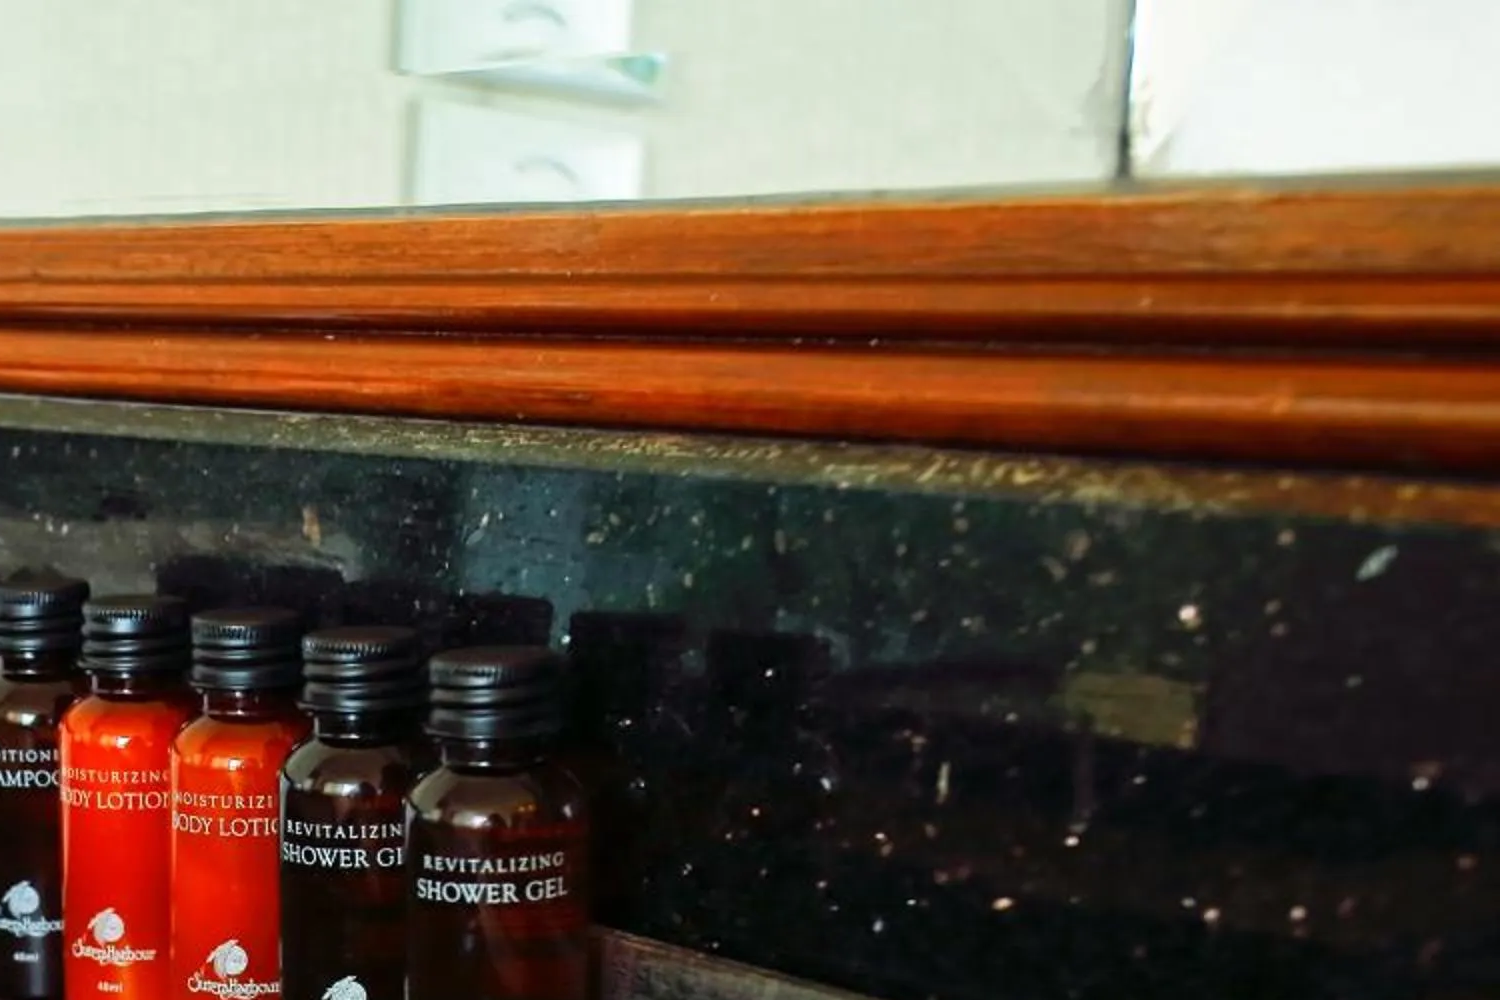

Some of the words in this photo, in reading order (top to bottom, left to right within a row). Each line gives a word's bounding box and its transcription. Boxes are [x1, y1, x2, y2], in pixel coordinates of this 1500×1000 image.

[219, 817, 277, 837] LOTI
[286, 819, 403, 839] REVITALIZIN
[283, 841, 370, 869] SHOWER
[423, 851, 565, 874] REVITALIZING
[416, 877, 520, 904] SHOWER
[525, 876, 568, 901] GEL
